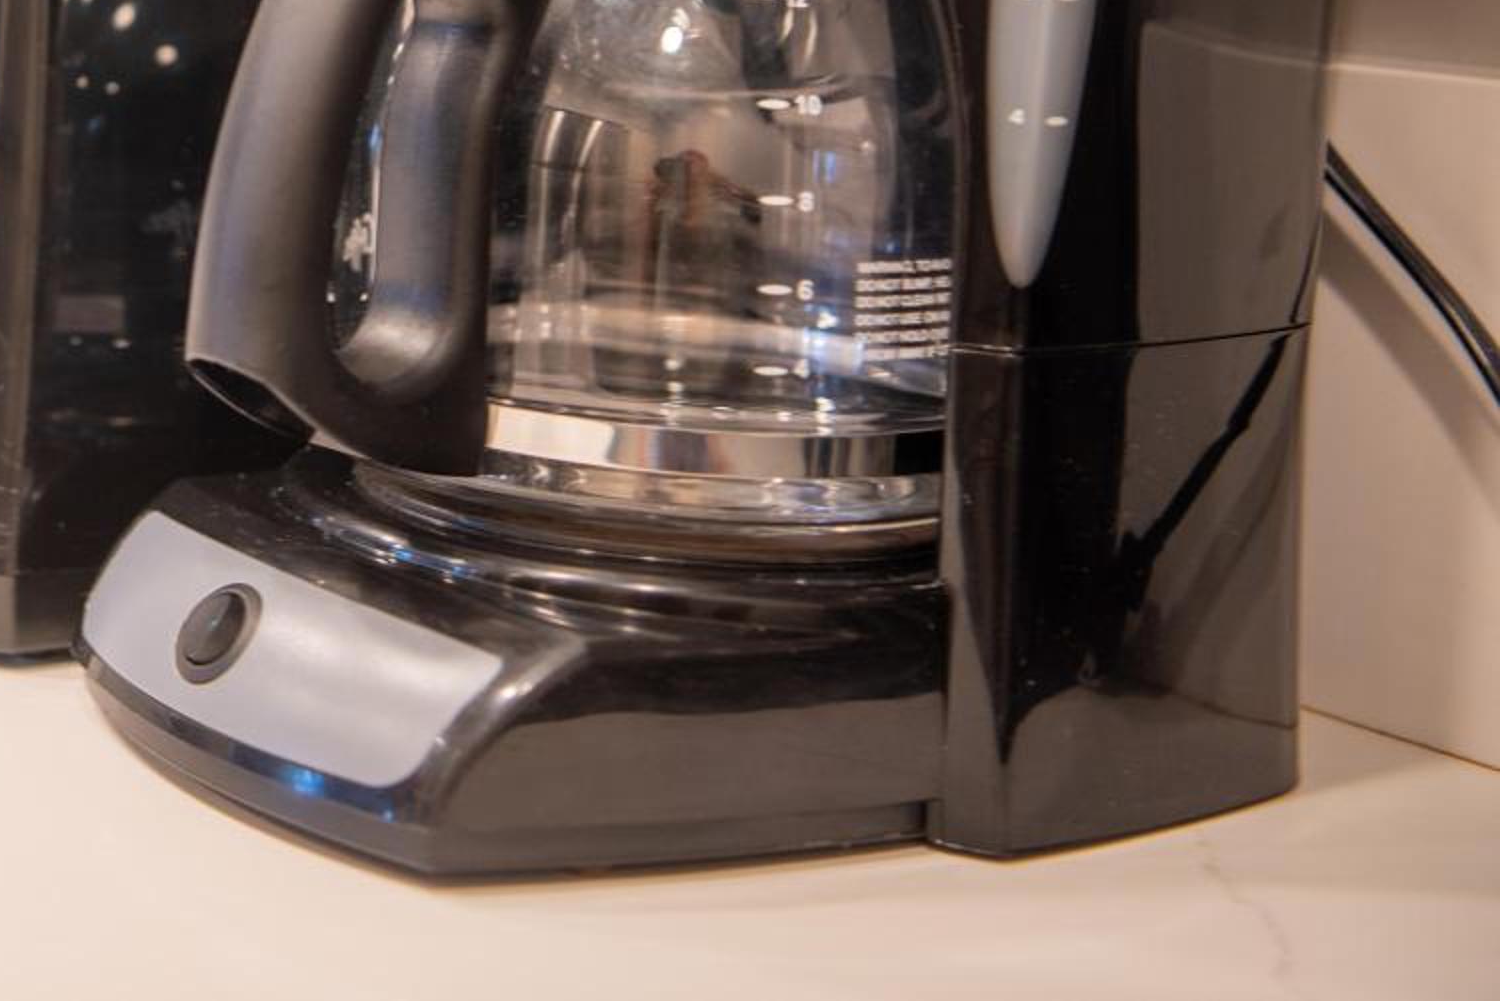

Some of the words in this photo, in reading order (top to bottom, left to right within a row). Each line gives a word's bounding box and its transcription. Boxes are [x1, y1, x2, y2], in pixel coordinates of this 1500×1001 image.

[795, 94, 822, 116] 10
[798, 191, 815, 213] 8
[797, 279, 815, 301] 6
[794, 358, 811, 379] 4
